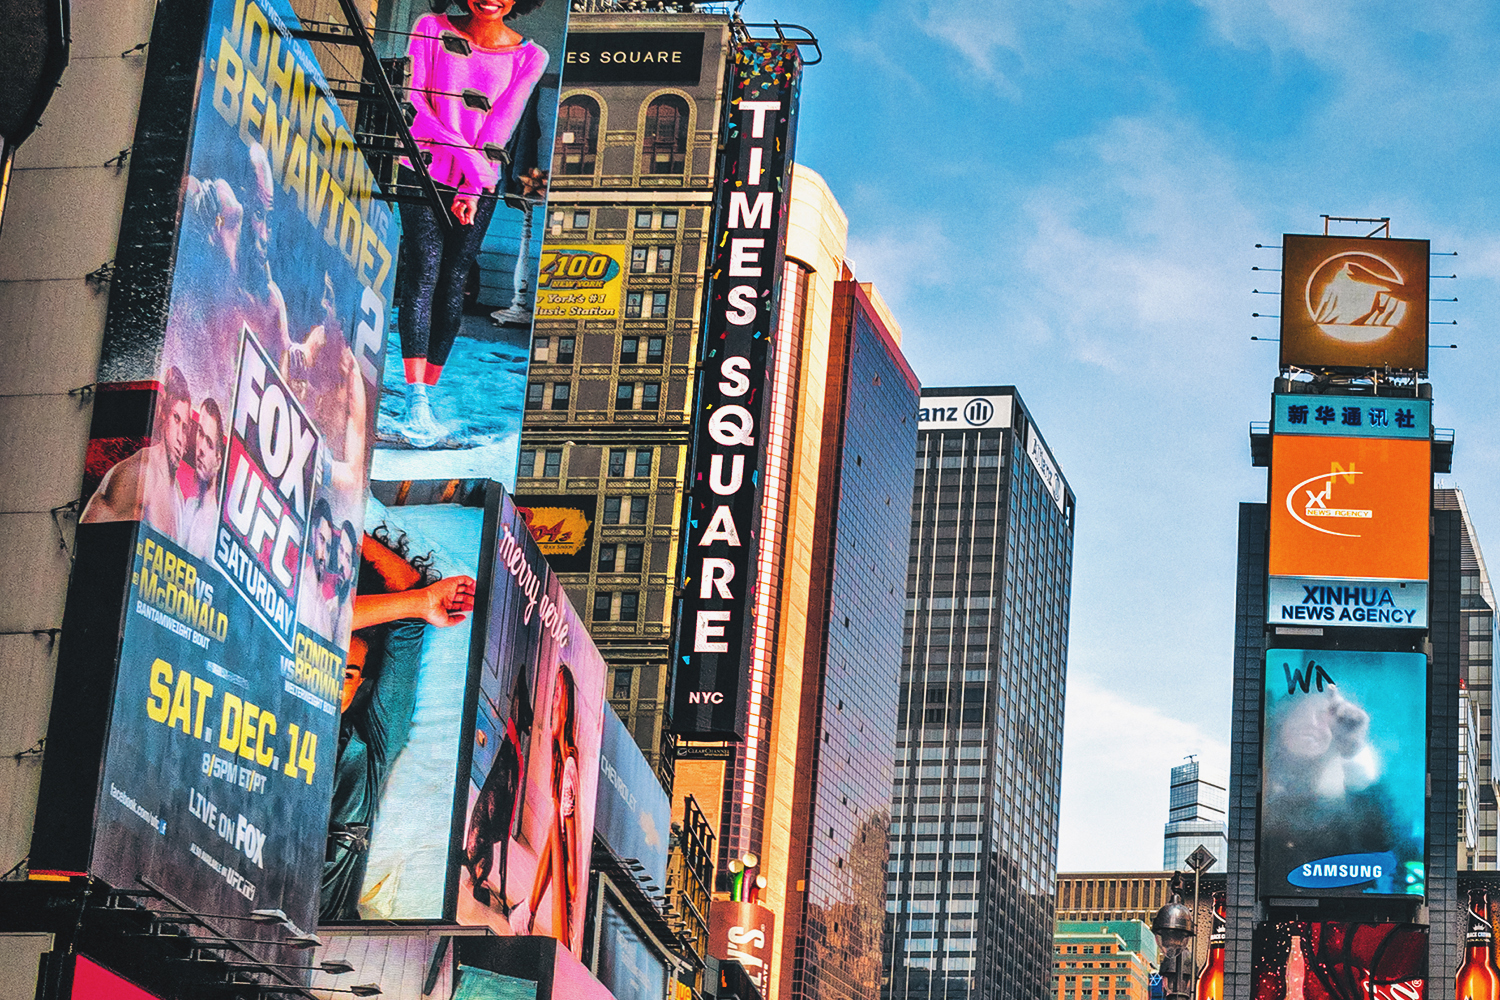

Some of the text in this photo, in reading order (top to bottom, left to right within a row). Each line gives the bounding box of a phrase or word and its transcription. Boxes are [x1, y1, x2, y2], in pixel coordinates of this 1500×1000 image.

[600, 51, 682, 63] SQUARE
[221, 0, 375, 200] JOHNSON
[212, 35, 392, 294] BENAVIDEZ
[726, 101, 781, 325] TIMES
[544, 294, 605, 305] York's #1
[551, 280, 604, 289] NEW YORK
[568, 305, 615, 316] Station
[353, 286, 388, 387] 2
[234, 348, 316, 522] FOX
[1288, 405, 1416, 429] 新华通讯社
[227, 453, 302, 589] UFC
[694, 356, 755, 653] SQUARE
[142, 538, 197, 590] FABER
[217, 527, 295, 638] SATURDAY
[500, 526, 540, 625] merry
[136, 601, 192, 641] BANTAMWEIGHT
[138, 566, 229, 643] McDONALD
[1282, 605, 1416, 623] NEWS AGENCY
[1302, 585, 1396, 607] XINHUA
[295, 632, 342, 668] CONDIT
[295, 655, 341, 704] BROWN
[689, 691, 723, 704] NYC
[146, 658, 213, 743] SAT.
[219, 691, 279, 770] DEC.
[284, 724, 317, 784] 14
[202, 753, 267, 794] 8/5PM ET/PT
[600, 754, 637, 811] CHEVROLET
[188, 787, 267, 869] LIVE ON FOX
[1302, 863, 1382, 880] SAMSUNG
